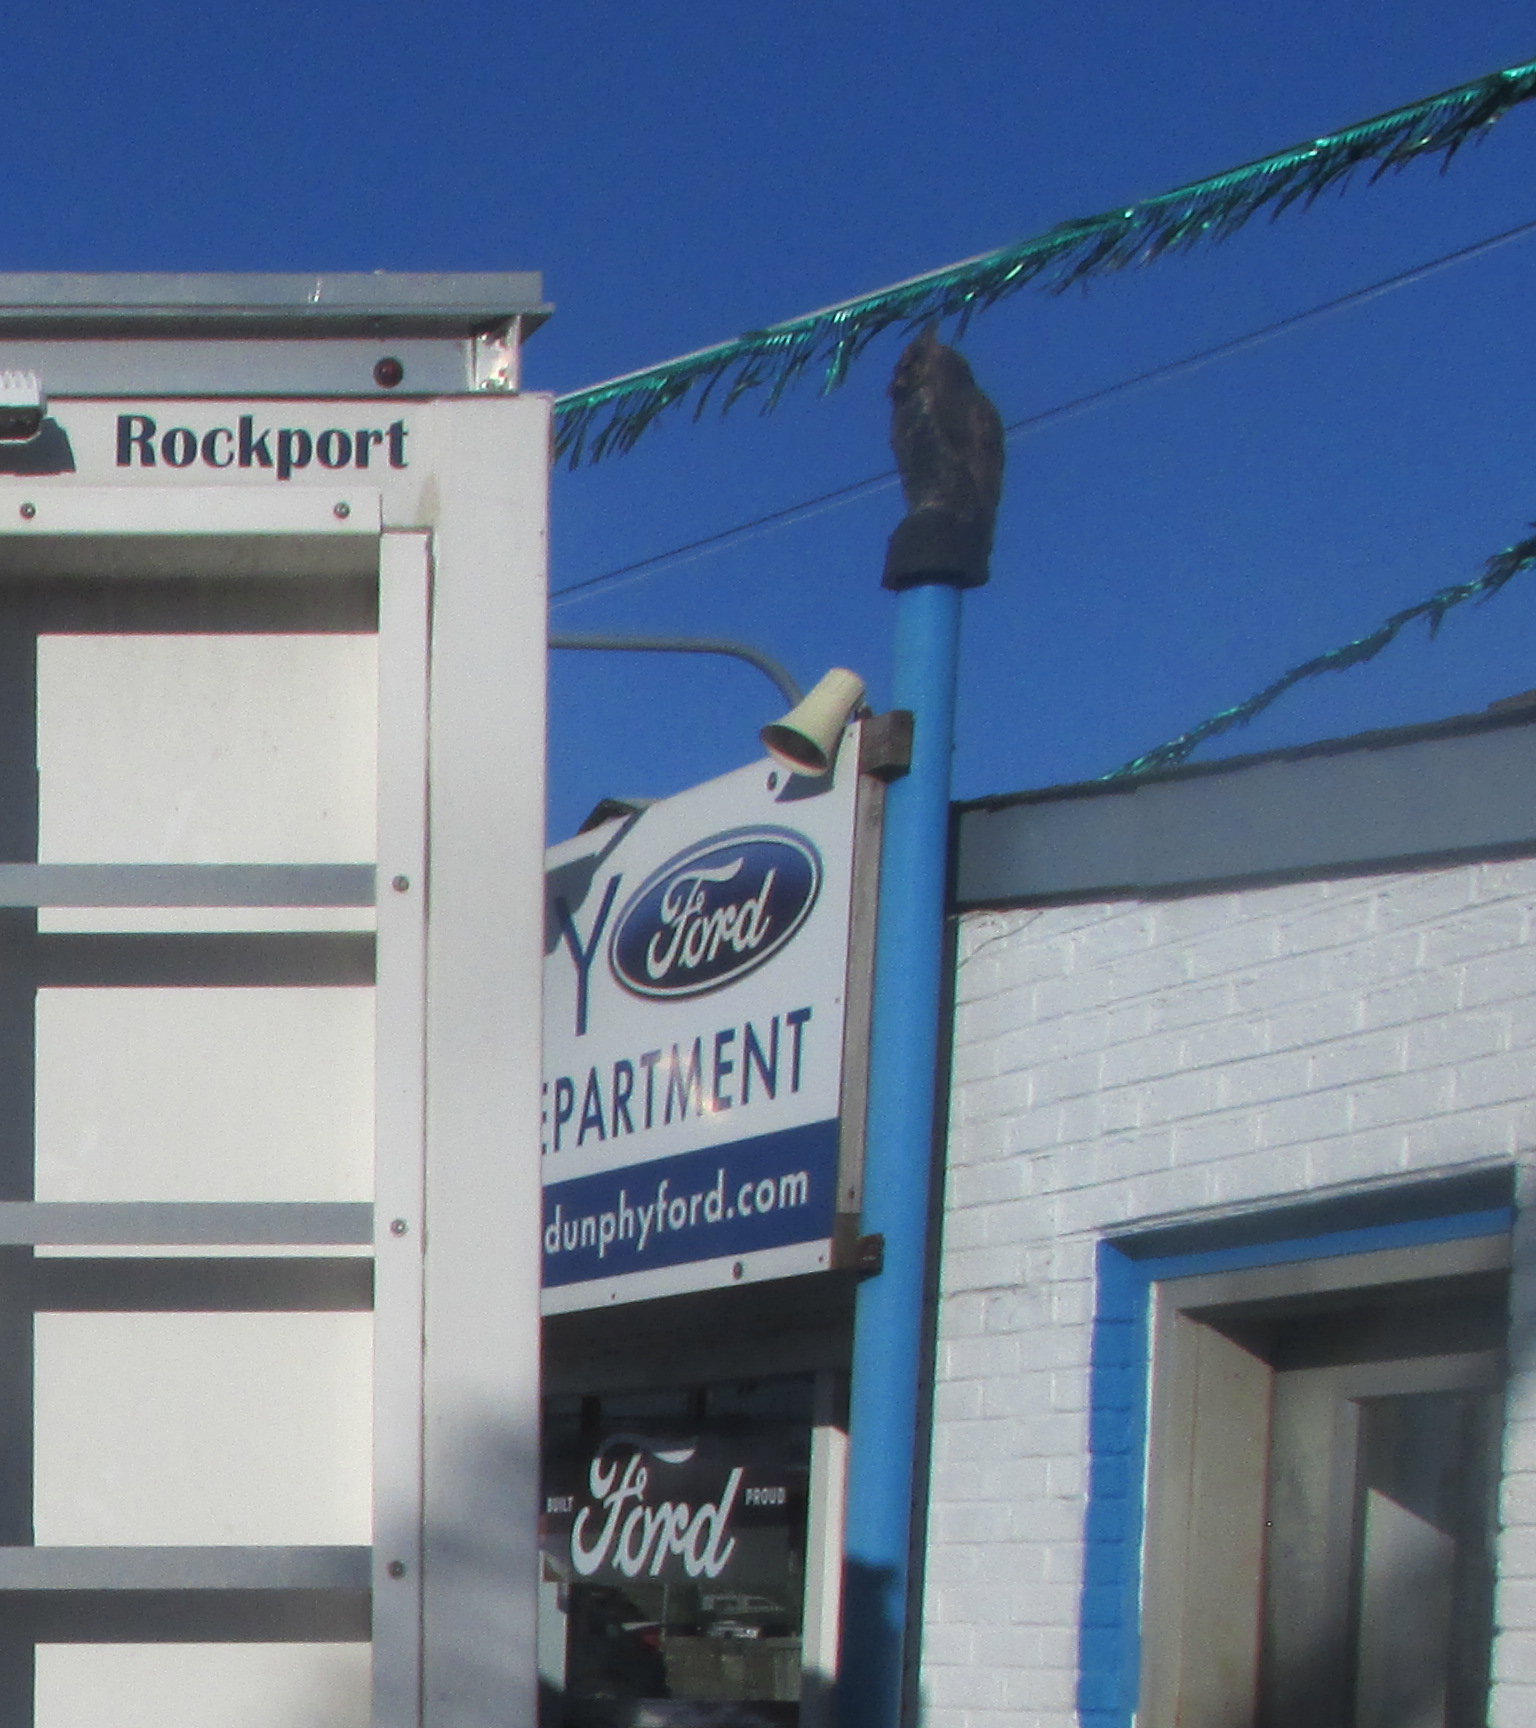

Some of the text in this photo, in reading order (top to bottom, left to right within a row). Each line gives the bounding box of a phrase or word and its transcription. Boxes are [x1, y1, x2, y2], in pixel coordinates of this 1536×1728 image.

[115, 414, 410, 481] Rockport
[646, 857, 777, 980] Ford
[544, 1167, 810, 1259] dunphyford.com
[571, 1433, 744, 1578] Ford
[744, 1486, 787, 1505] PROUD
